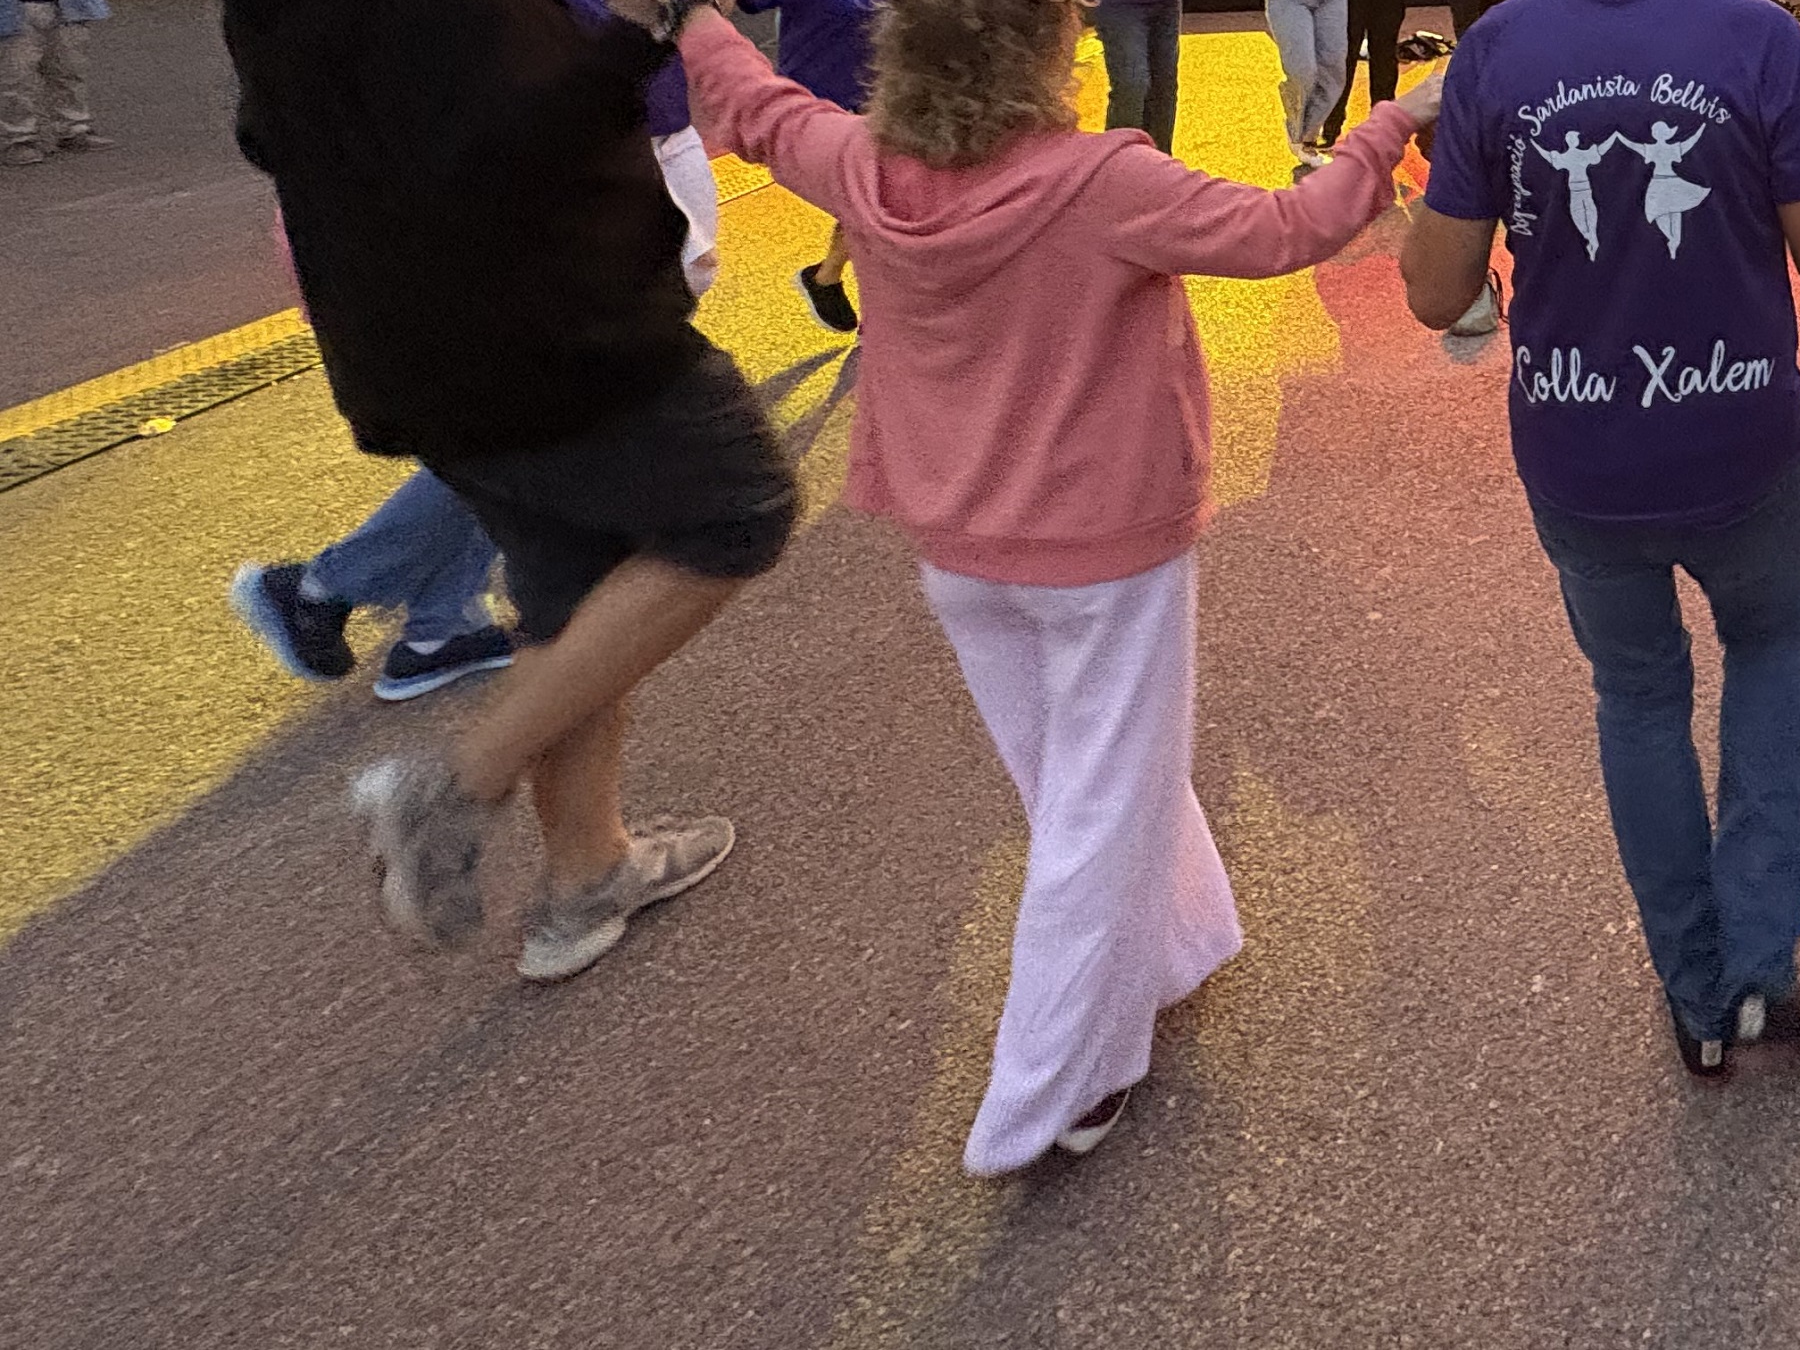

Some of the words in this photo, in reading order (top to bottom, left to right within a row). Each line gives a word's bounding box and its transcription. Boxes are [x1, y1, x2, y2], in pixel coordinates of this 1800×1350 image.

[1517, 74, 1642, 137] Sardanista
[1516, 345, 1618, 404] Colla
[1632, 339, 1776, 408] Xalem
